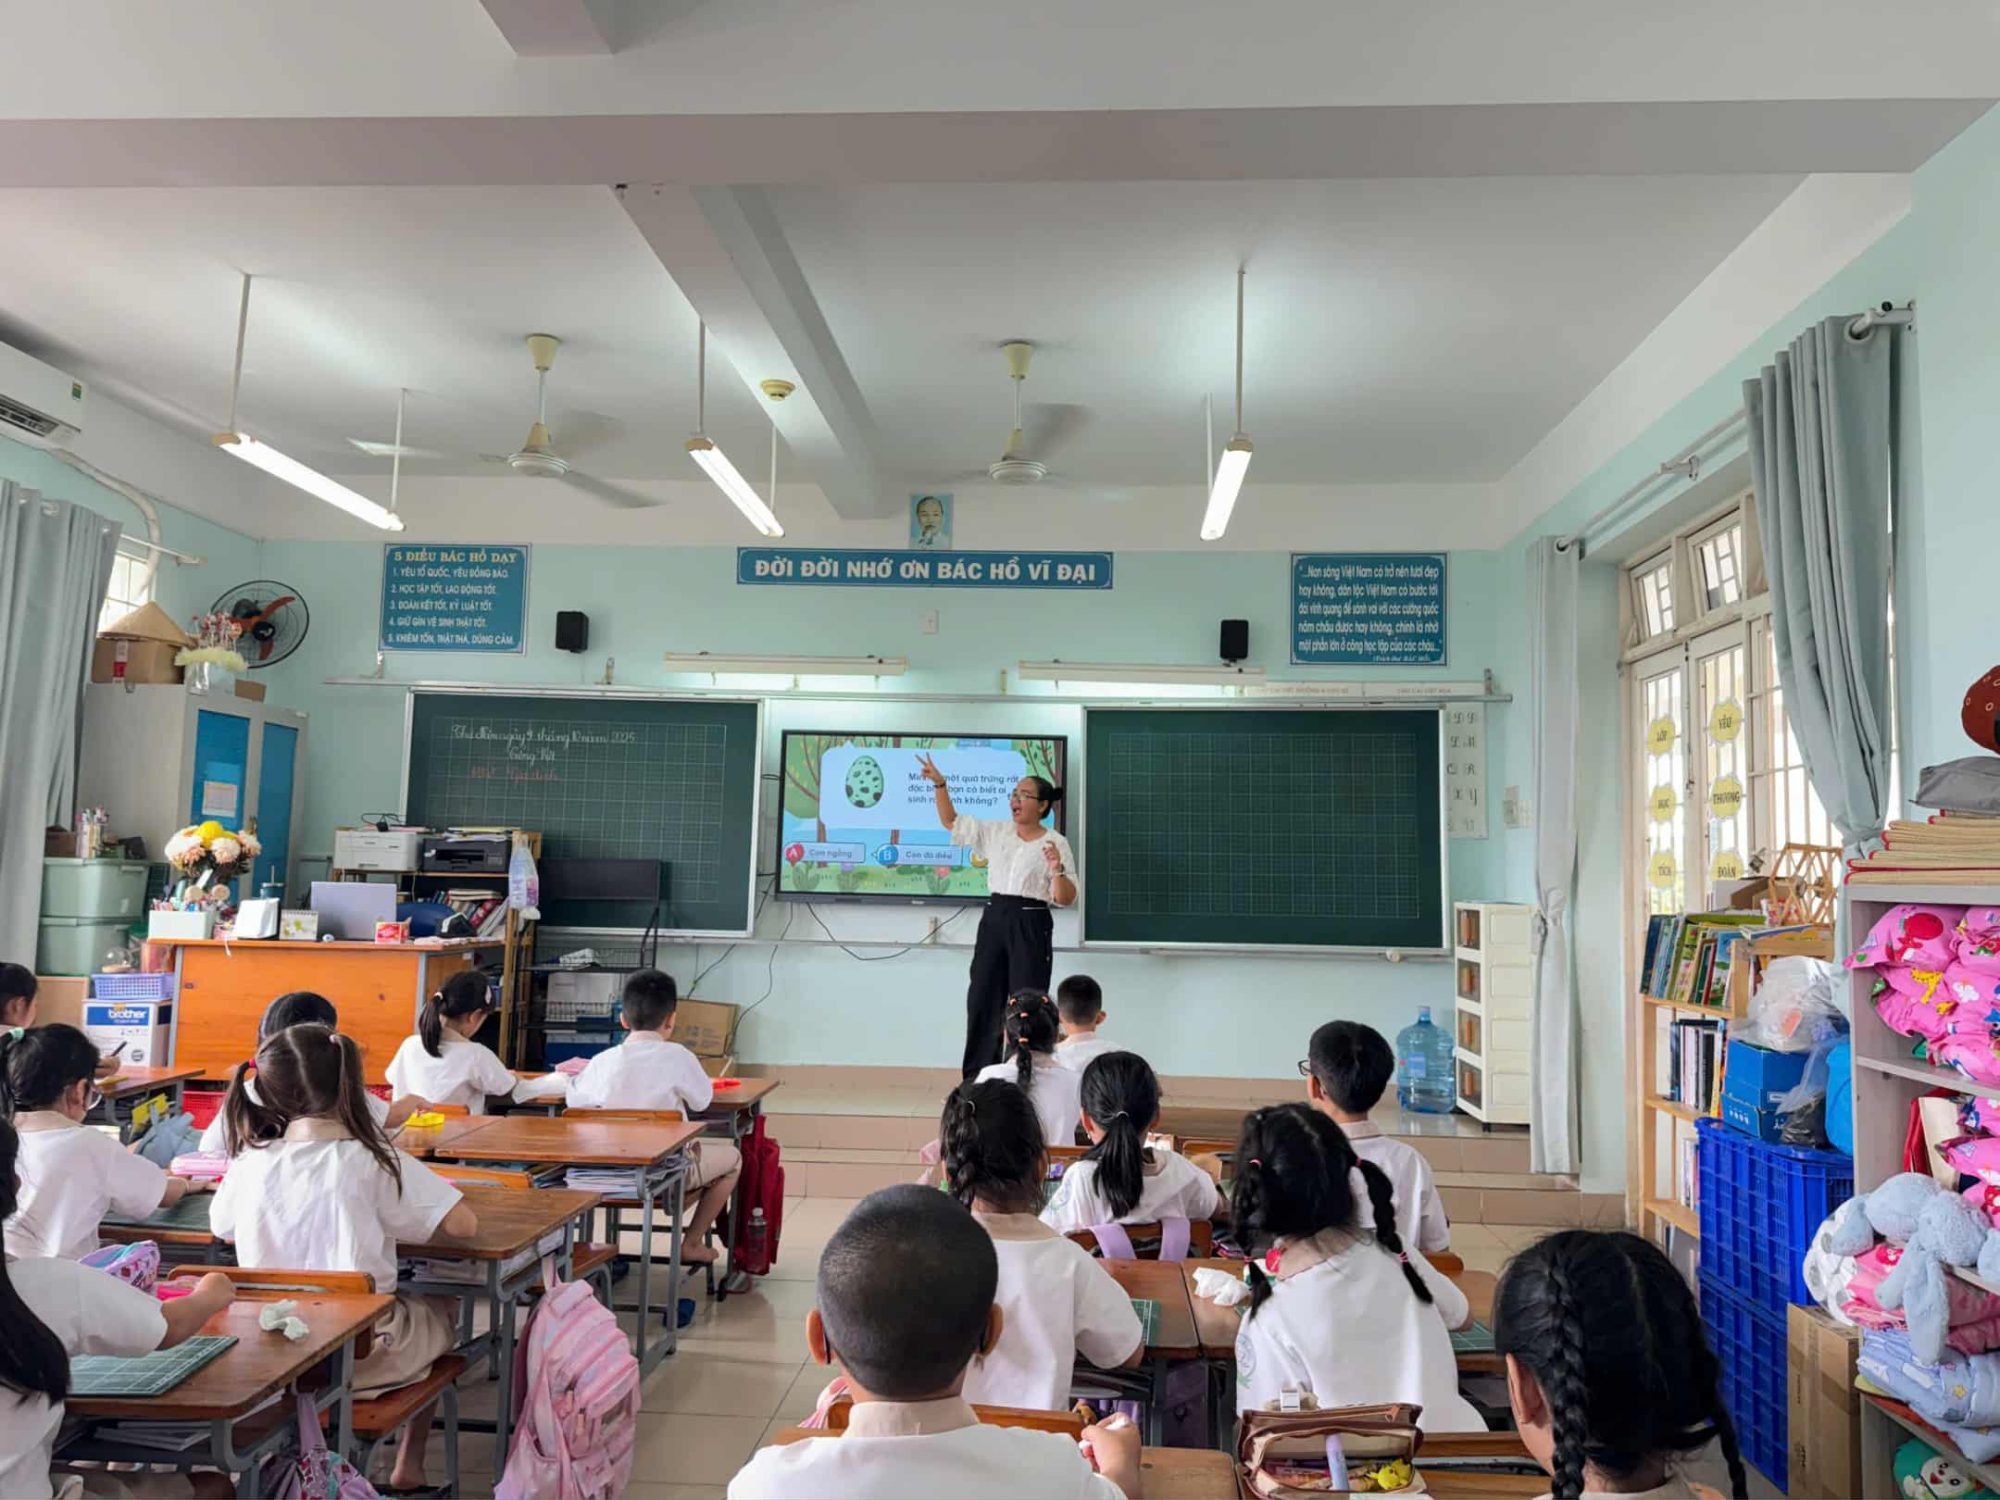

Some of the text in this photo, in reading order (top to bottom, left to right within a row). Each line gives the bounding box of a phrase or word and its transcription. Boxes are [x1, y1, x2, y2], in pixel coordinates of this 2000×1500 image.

[394, 547, 517, 565] 5 ĐIỀU BÁC HỒ DẠY
[755, 556, 1096, 584] ĐỜI ĐỜI NHỚ ƠN BÁC HỒ VĨ ĐẠI
[1356, 565, 1372, 578] Nam
[445, 585, 459, 594] LAO
[1381, 584, 1397, 597] Nam
[1718, 713, 1732, 729] YÊU
[1656, 729, 1668, 742] LỚP
[1718, 863, 1737, 878] ĐOÀN
